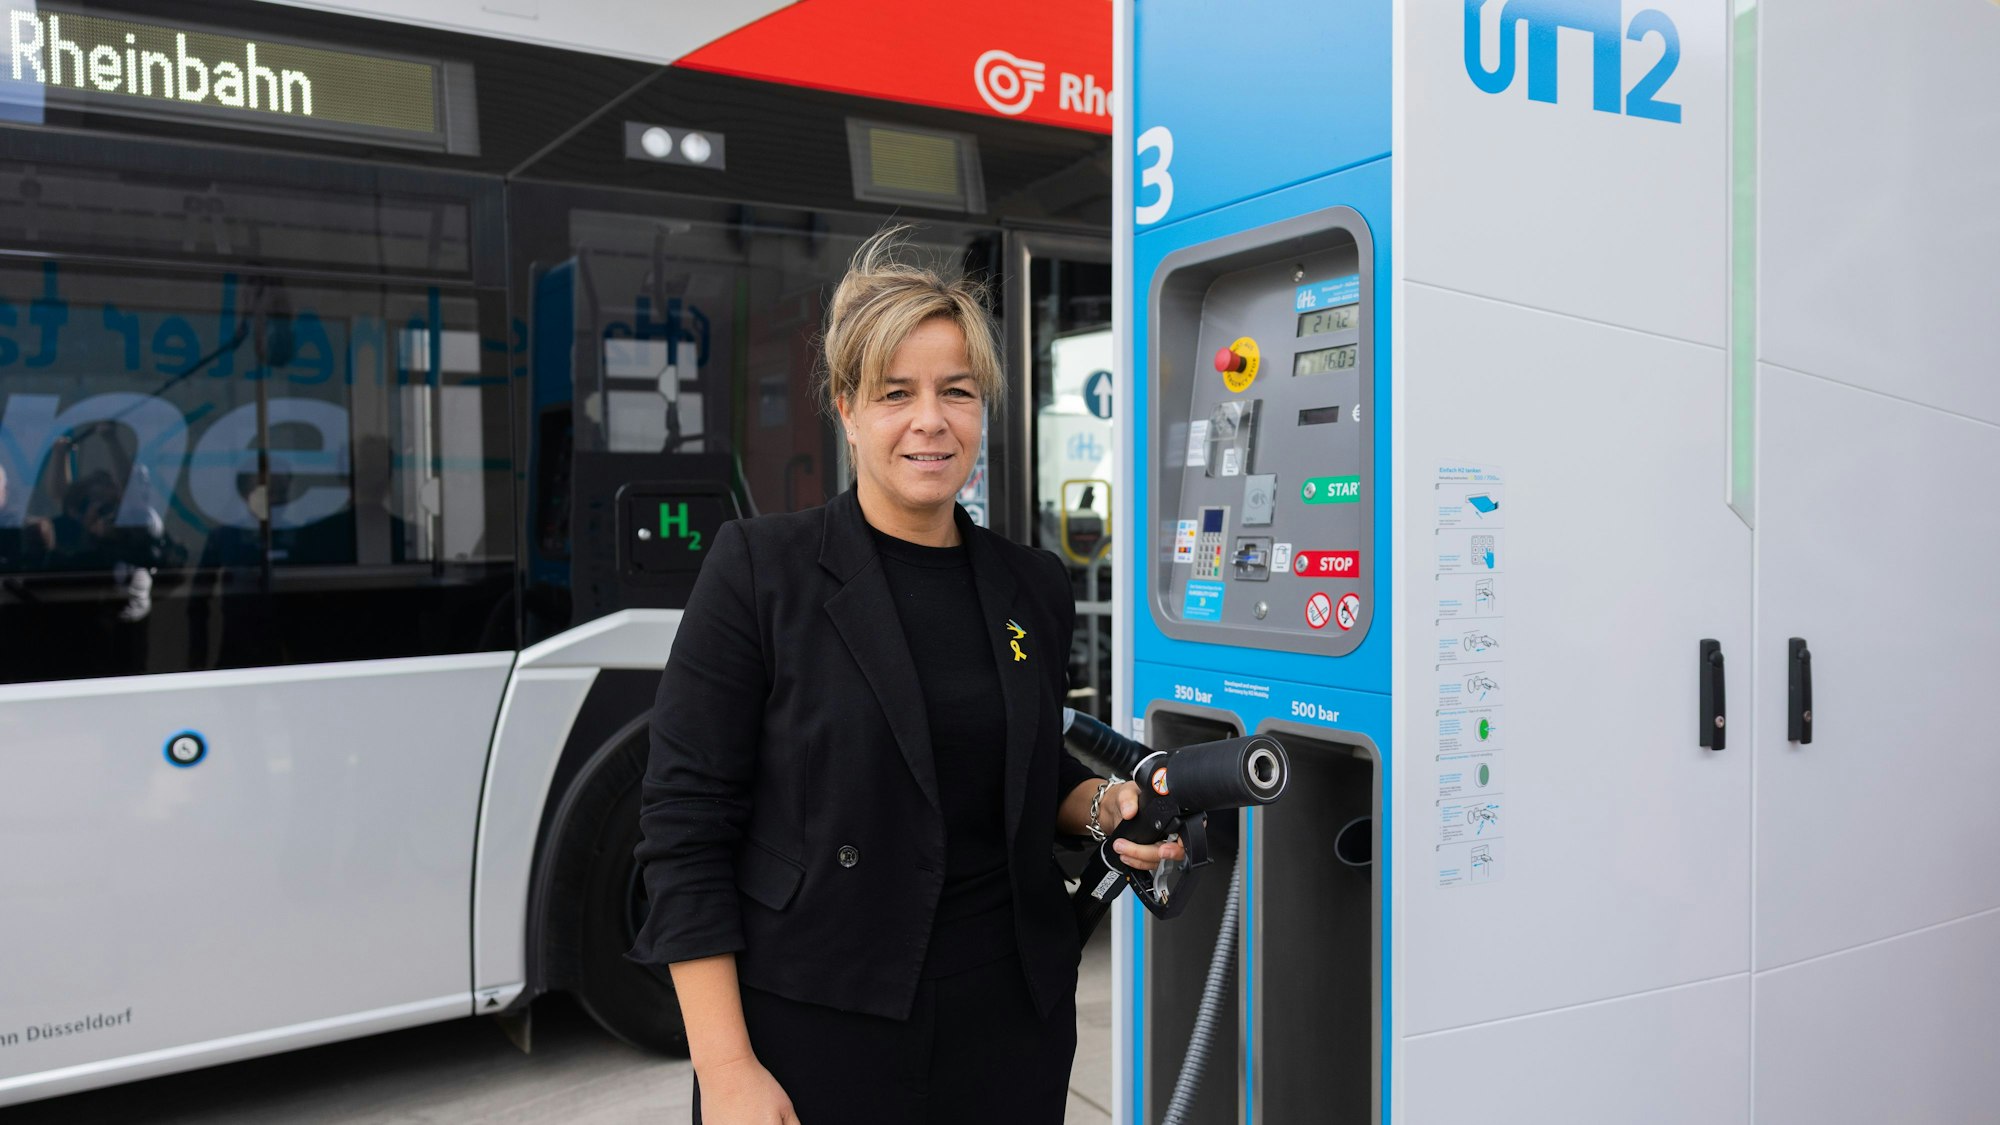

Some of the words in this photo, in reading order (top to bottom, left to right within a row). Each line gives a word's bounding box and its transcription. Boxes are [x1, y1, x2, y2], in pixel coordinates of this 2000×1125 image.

[10, 9, 312, 116] Rheinbahn
[1136, 125, 1174, 225] 3
[1320, 557, 1353, 571] STOP
[1174, 684, 1194, 701] 350
[1195, 687, 1213, 704] bar
[1291, 700, 1316, 718] 500
[1318, 704, 1339, 722] bar
[26, 1006, 132, 1042] Düsseldorf
